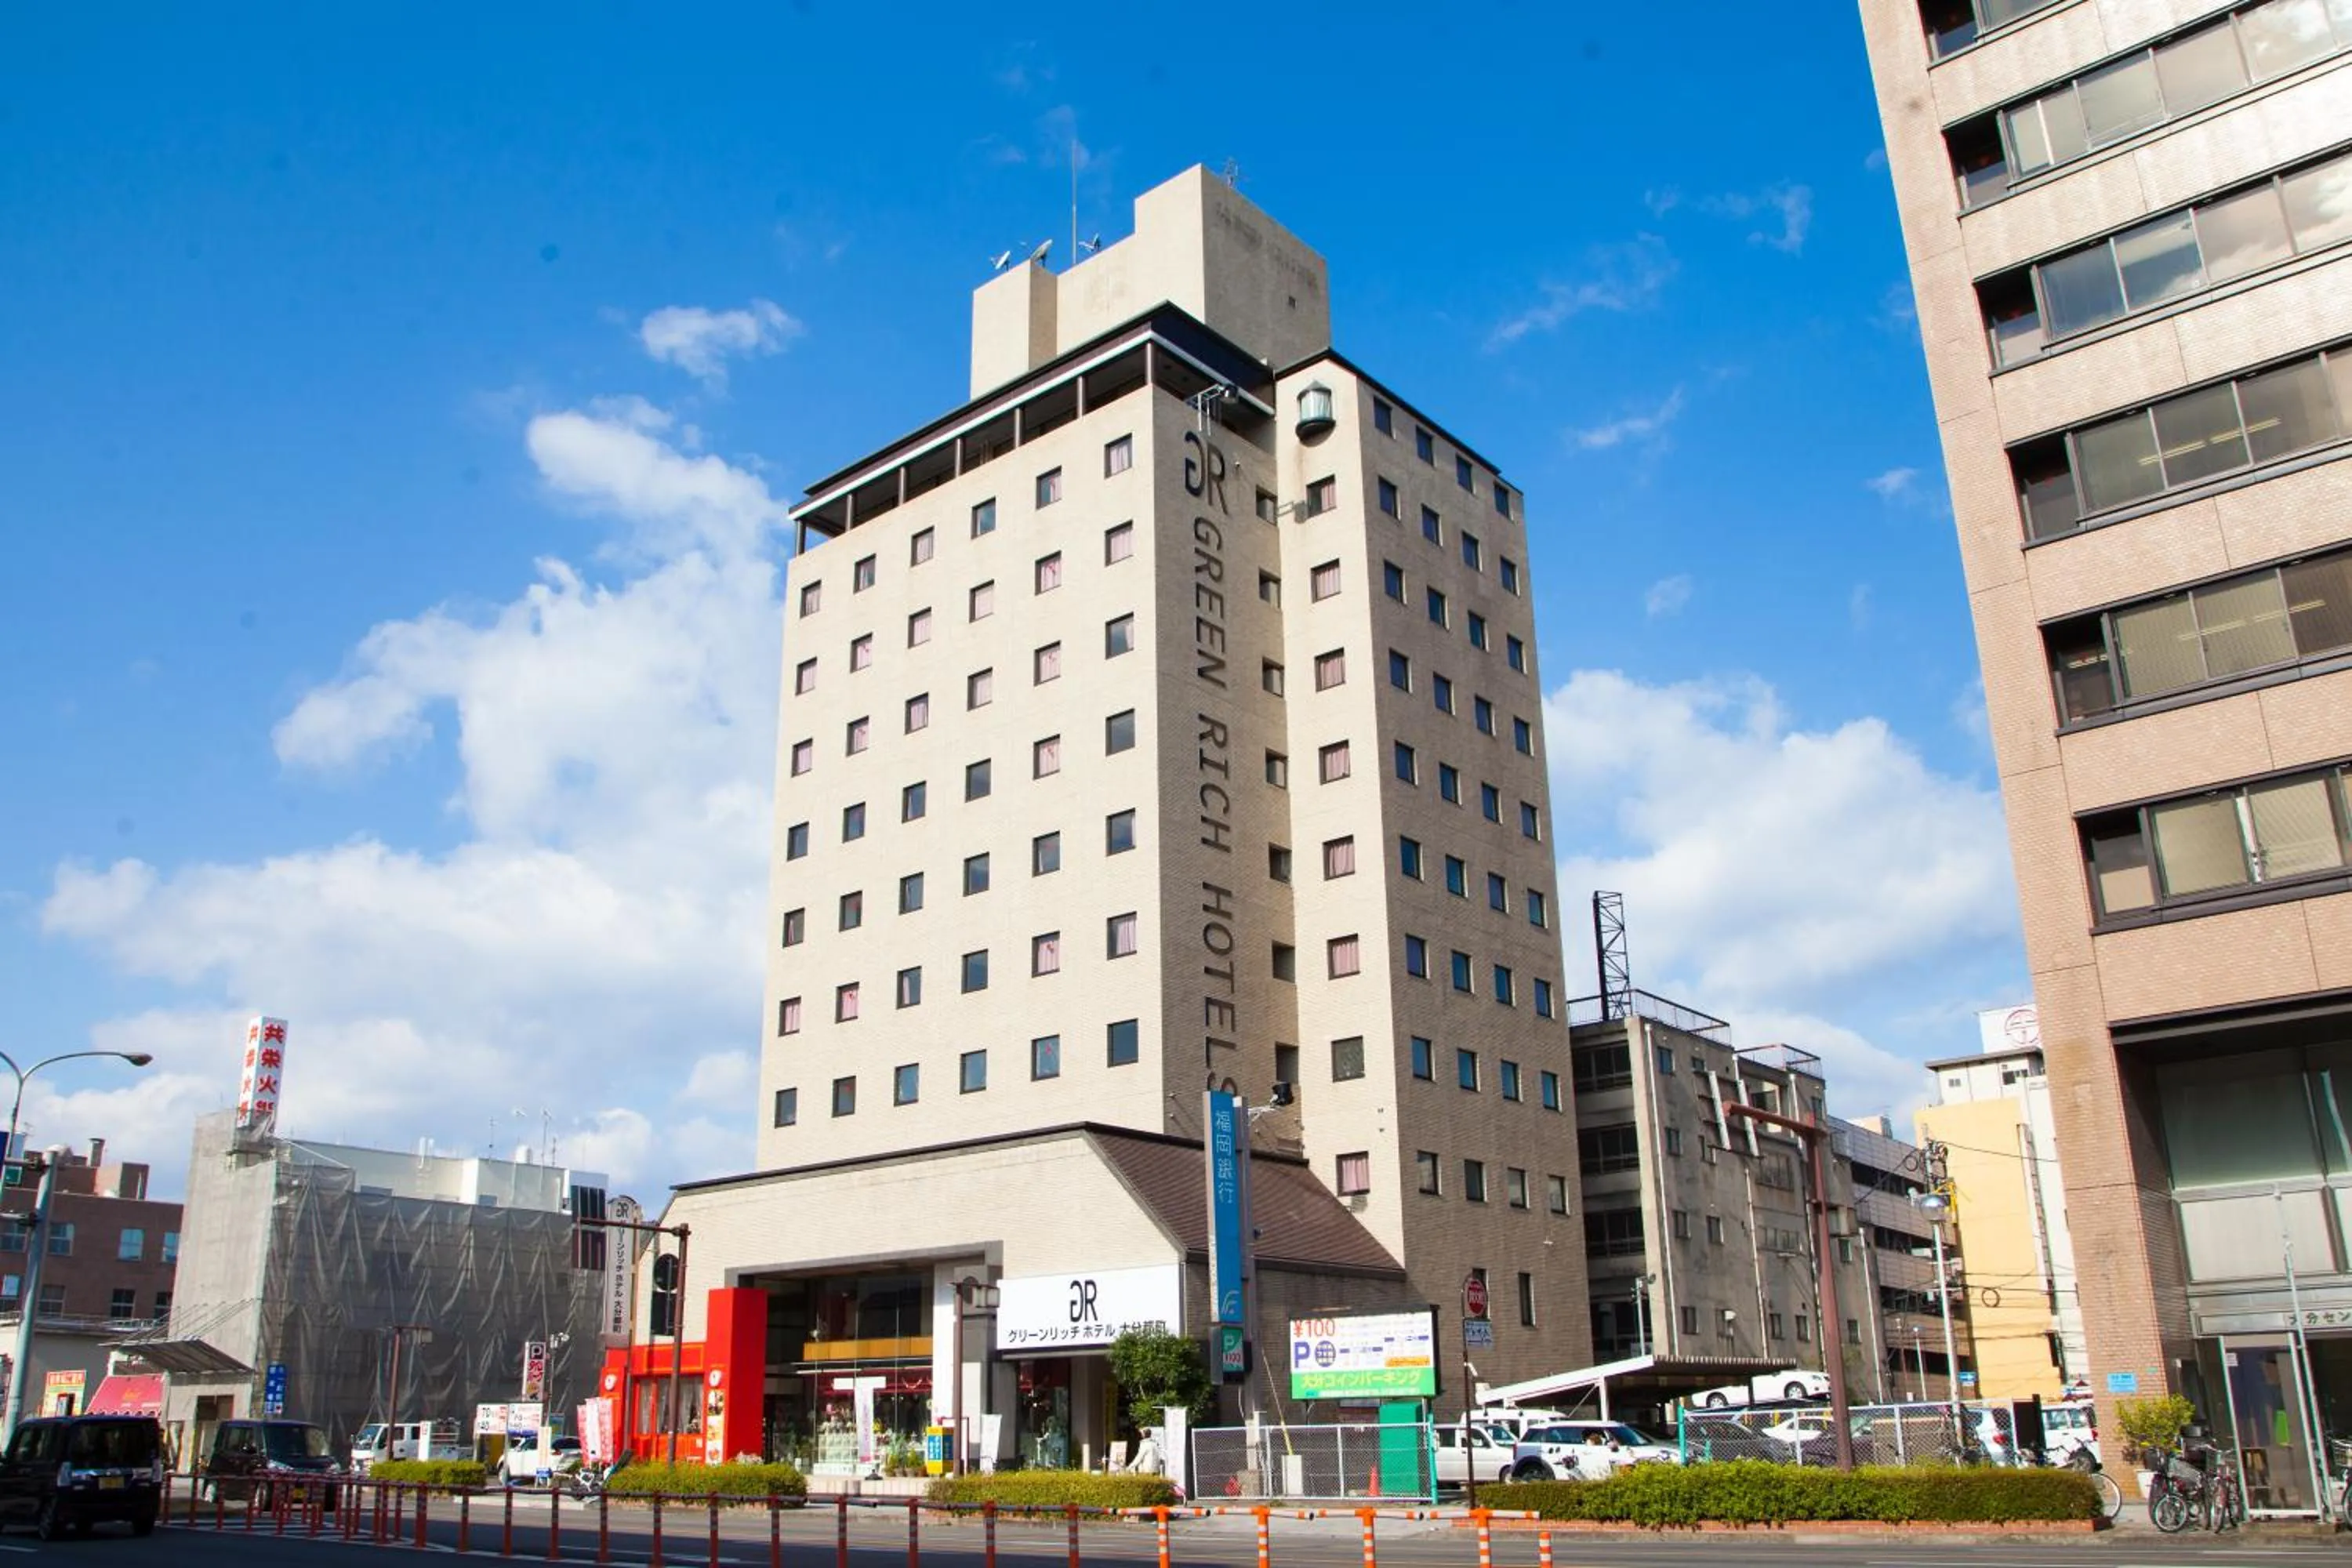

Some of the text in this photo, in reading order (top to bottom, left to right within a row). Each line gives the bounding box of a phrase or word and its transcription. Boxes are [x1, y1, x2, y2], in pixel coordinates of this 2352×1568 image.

[1194, 517, 1237, 1096] GREEN RICH HOTELS
[1216, 1110, 1234, 1204] 福岡銀行
[615, 1274, 623, 1298] ホテル
[1008, 1327, 1080, 1343] グリーンリッチ
[1083, 1323, 1116, 1338] ホテル
[1294, 1319, 1335, 1338] ¥100
[1224, 1335, 1235, 1351] P
[1294, 1341, 1311, 1369] P
[1302, 1372, 1421, 1388] 大分コインパーキング
